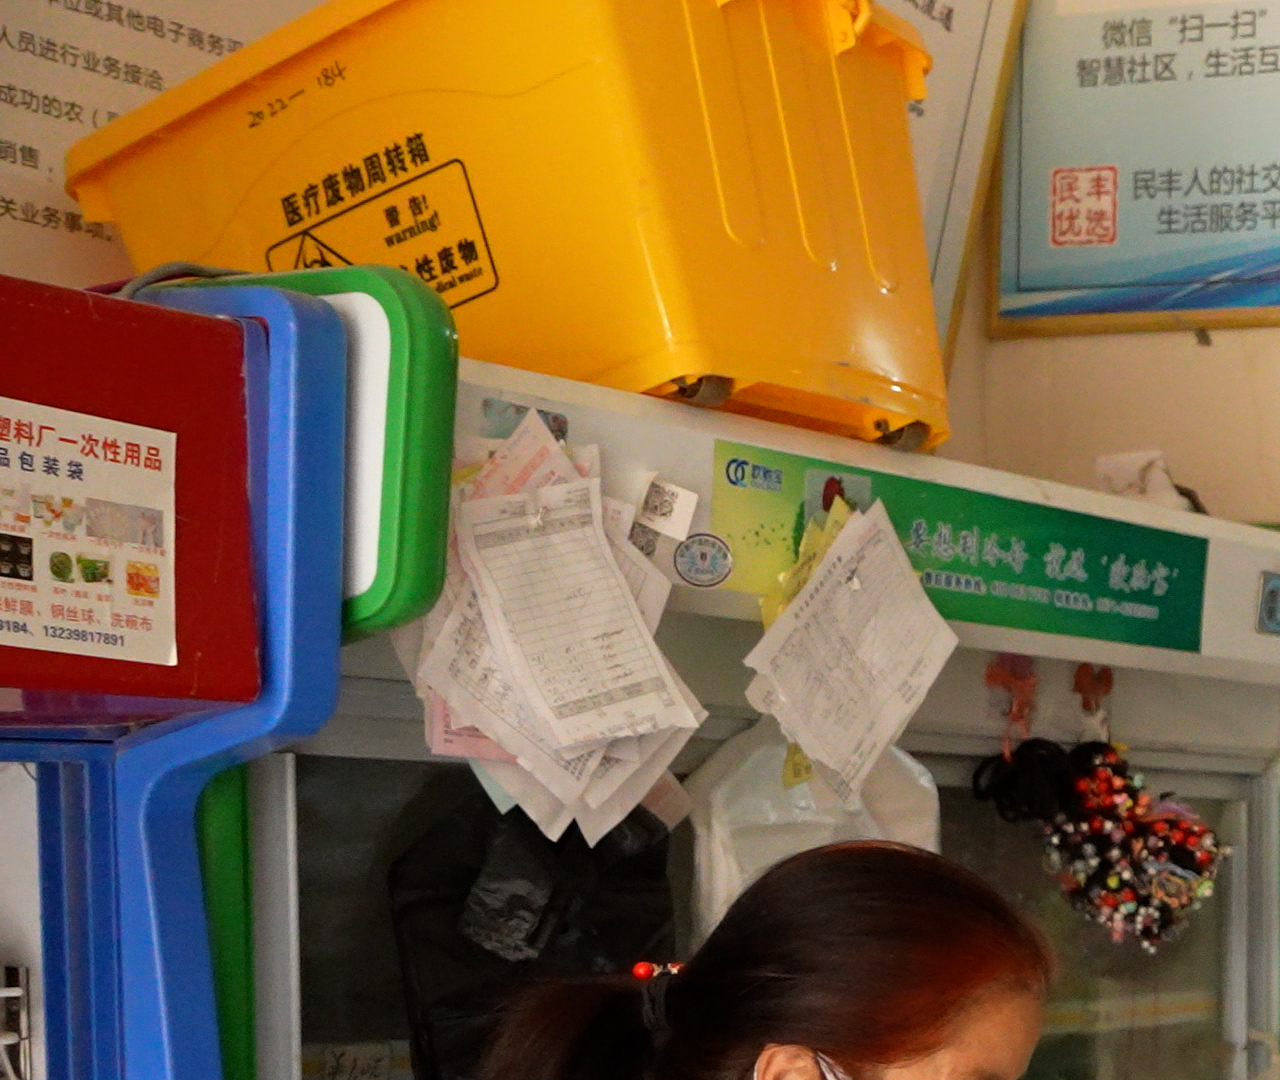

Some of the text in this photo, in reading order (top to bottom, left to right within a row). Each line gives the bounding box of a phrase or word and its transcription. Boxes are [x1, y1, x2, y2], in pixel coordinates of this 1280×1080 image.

[47, 0, 244, 56] 位或其他电子商务平
[280, 132, 431, 229] 医疗废物周转箱
[383, 210, 442, 248] warning!
[399, 238, 480, 284] 性废物
